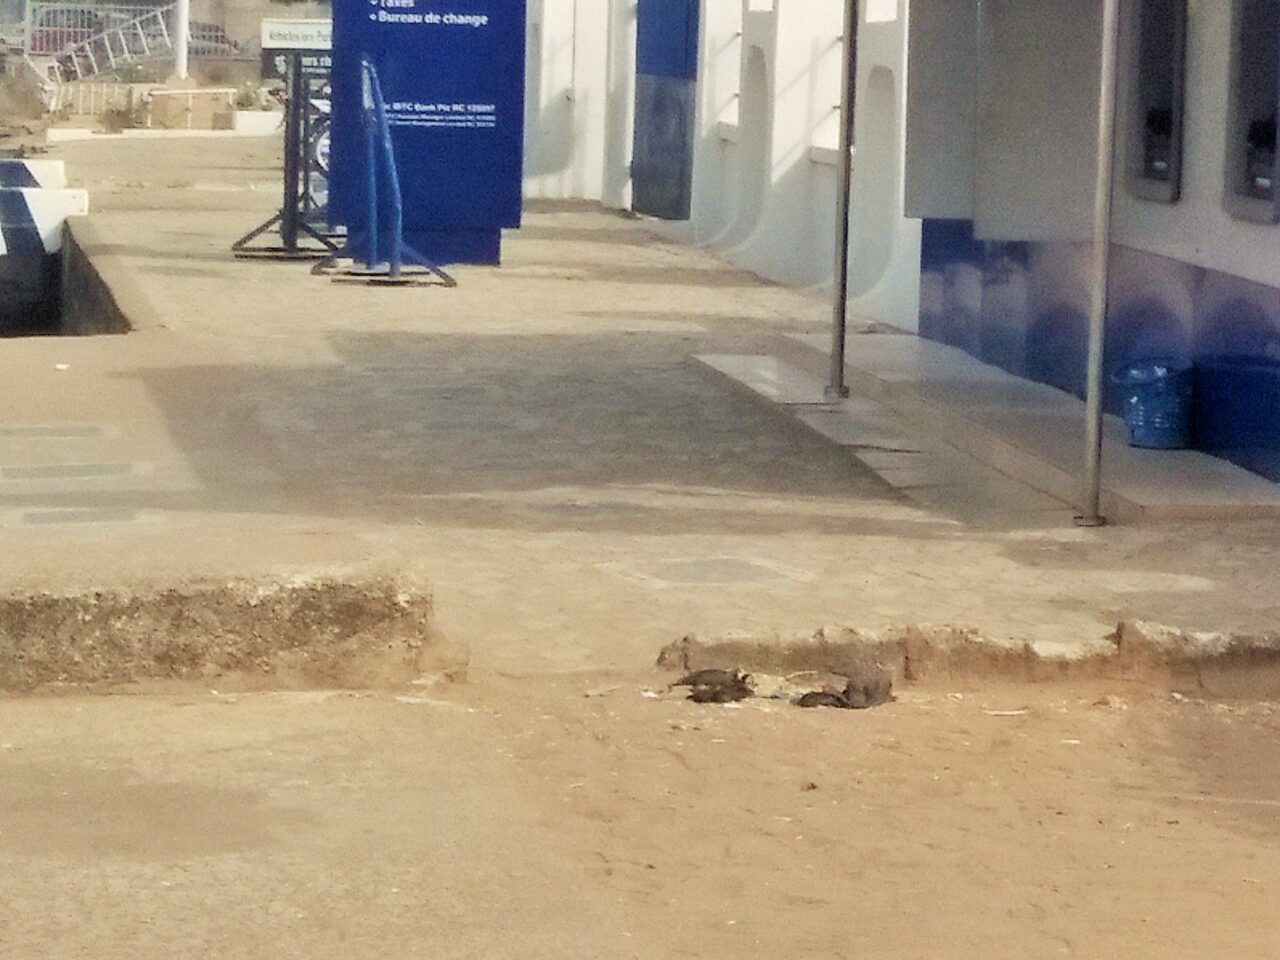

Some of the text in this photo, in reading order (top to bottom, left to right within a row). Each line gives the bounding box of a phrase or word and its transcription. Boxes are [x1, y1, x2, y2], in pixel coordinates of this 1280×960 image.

[378, 10, 489, 28] Bureau de change
